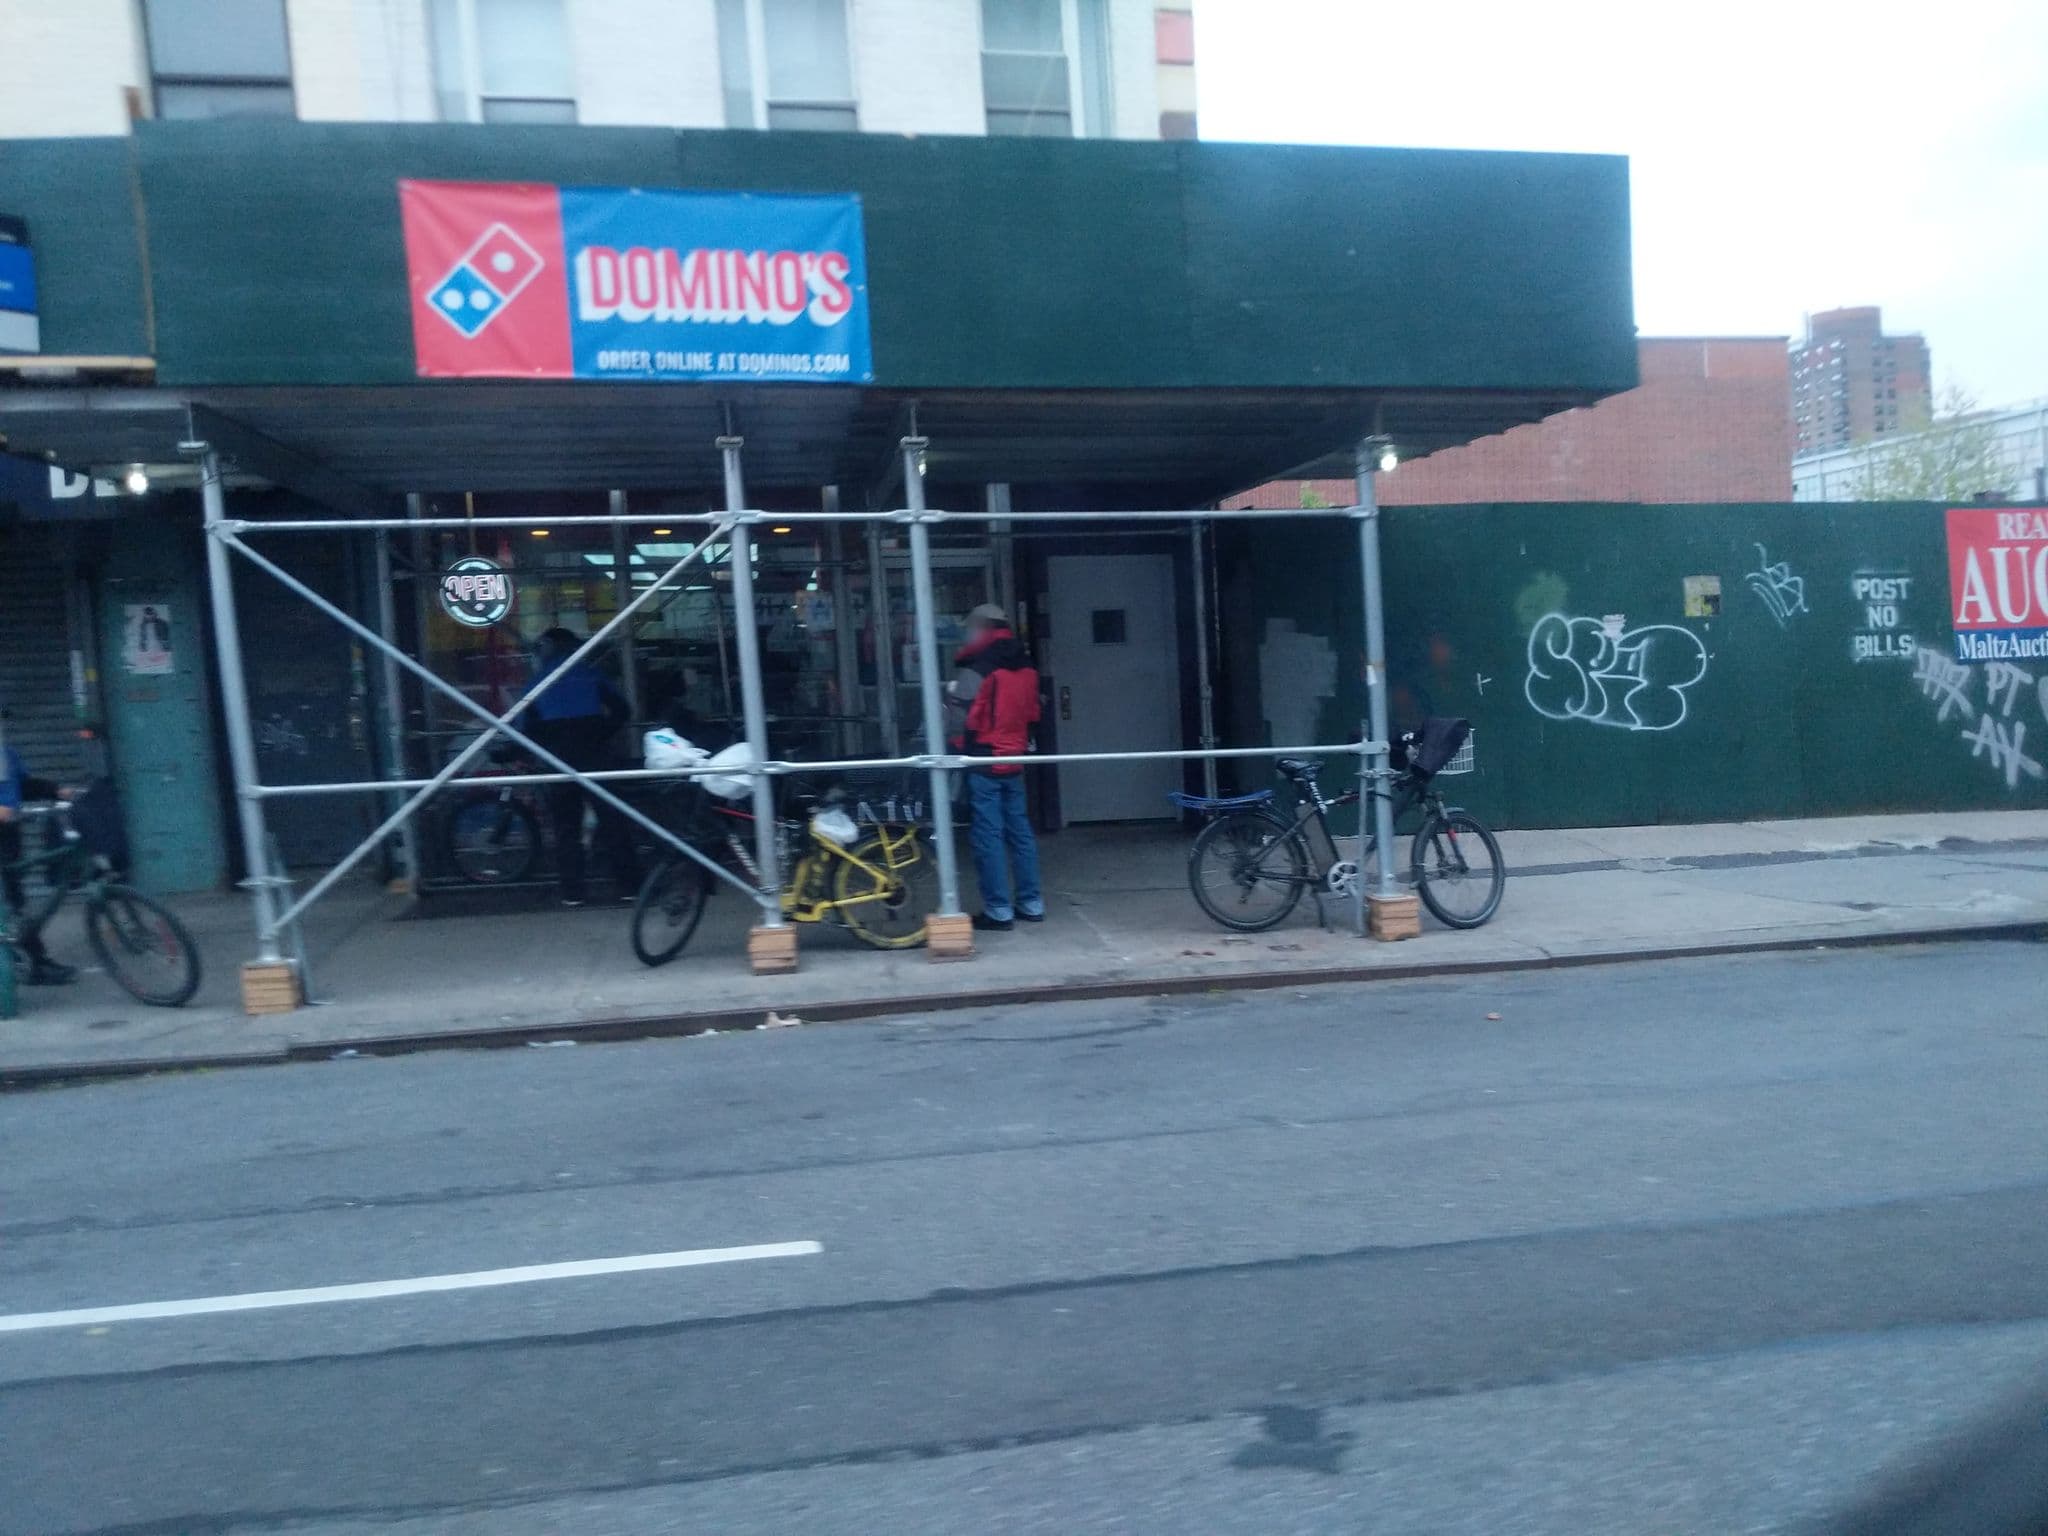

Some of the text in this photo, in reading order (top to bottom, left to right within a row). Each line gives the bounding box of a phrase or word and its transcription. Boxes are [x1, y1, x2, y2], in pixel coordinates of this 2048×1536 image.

[576, 246, 854, 327] DOMINO'S
[597, 350, 850, 374] ORDER ONLINE AT DOMINOS.COM
[445, 574, 506, 602] OPEN
[1855, 578, 1911, 600] POST
[1867, 605, 1898, 628] NO
[1855, 634, 1914, 658] BILLS
